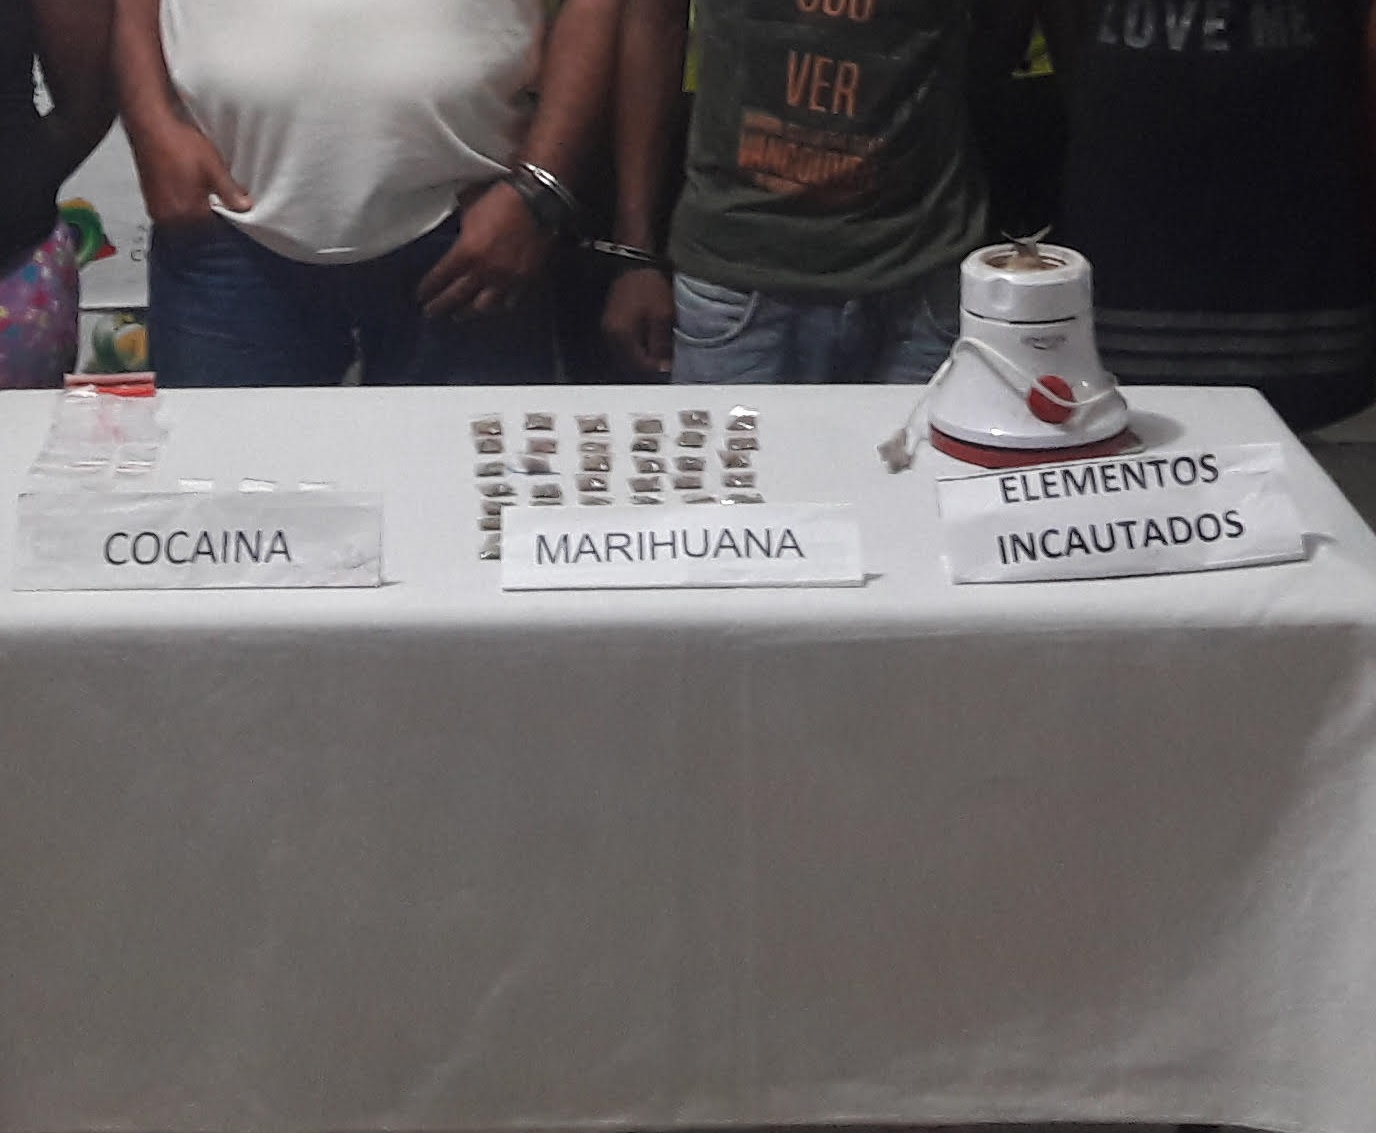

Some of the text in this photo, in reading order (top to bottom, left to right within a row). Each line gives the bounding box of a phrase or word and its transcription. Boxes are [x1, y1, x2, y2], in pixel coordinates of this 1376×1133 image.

[785, 49, 862, 118] VER
[999, 452, 1221, 504] ELEMENTOS
[102, 529, 293, 566] COCAINA
[535, 527, 808, 566] MARIHUANA
[996, 508, 1245, 565] INCAUTADOS
